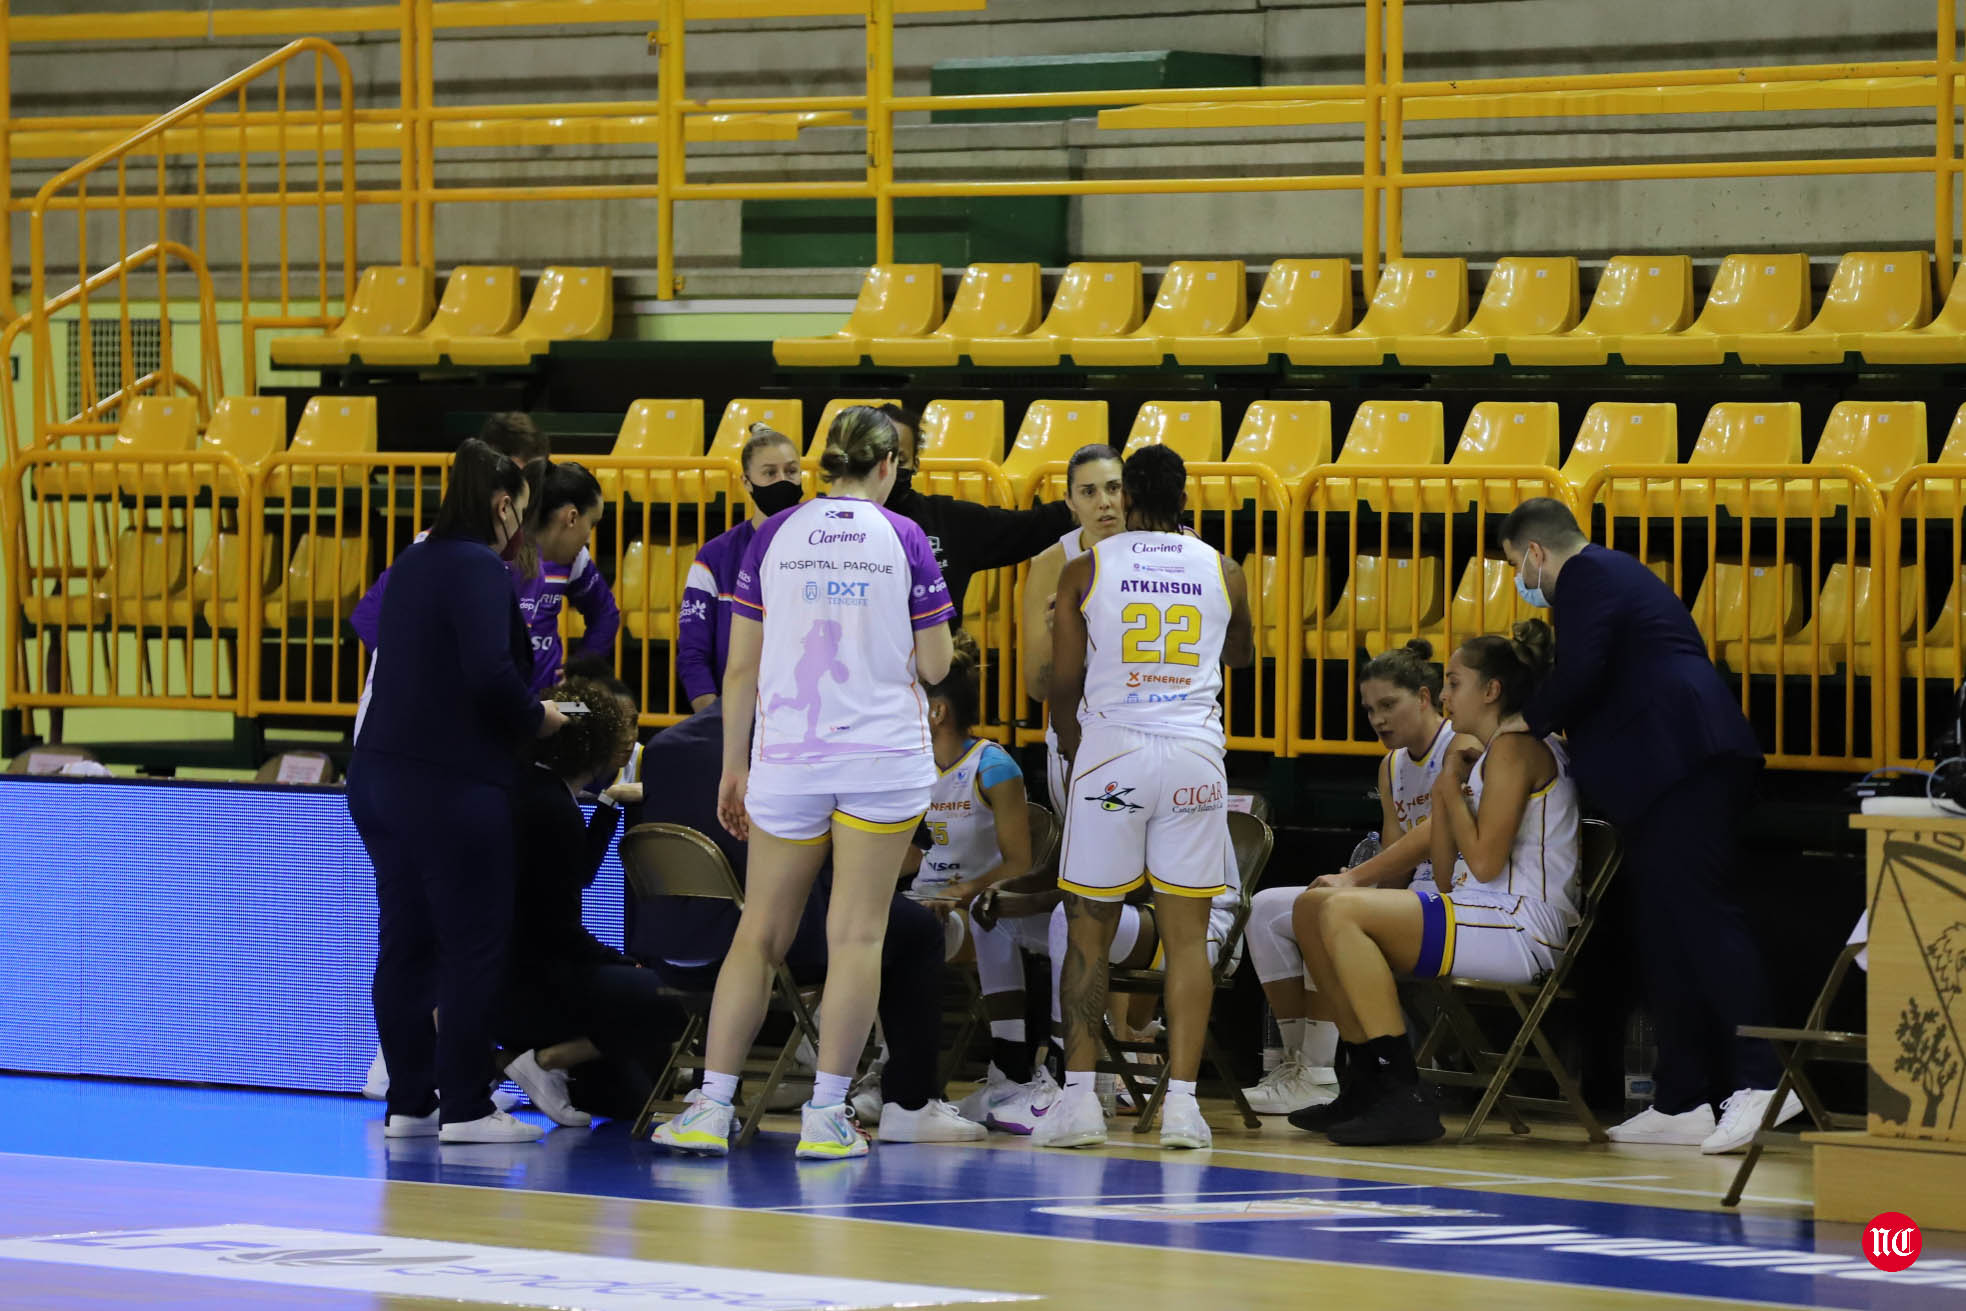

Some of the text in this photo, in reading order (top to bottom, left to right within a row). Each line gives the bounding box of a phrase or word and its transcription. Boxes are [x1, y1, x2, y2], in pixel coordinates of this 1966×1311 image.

[808, 529, 867, 546] Clarinos
[1132, 542, 1183, 554] Clarinos
[779, 560, 894, 575] HOSPITAL PARQUE
[827, 581, 870, 598] DXT
[1120, 580, 1203, 596] ATKINSON
[1121, 602, 1203, 668] 22
[1142, 674, 1192, 686] TENERIFE
[1172, 781, 1224, 807] CICAR
